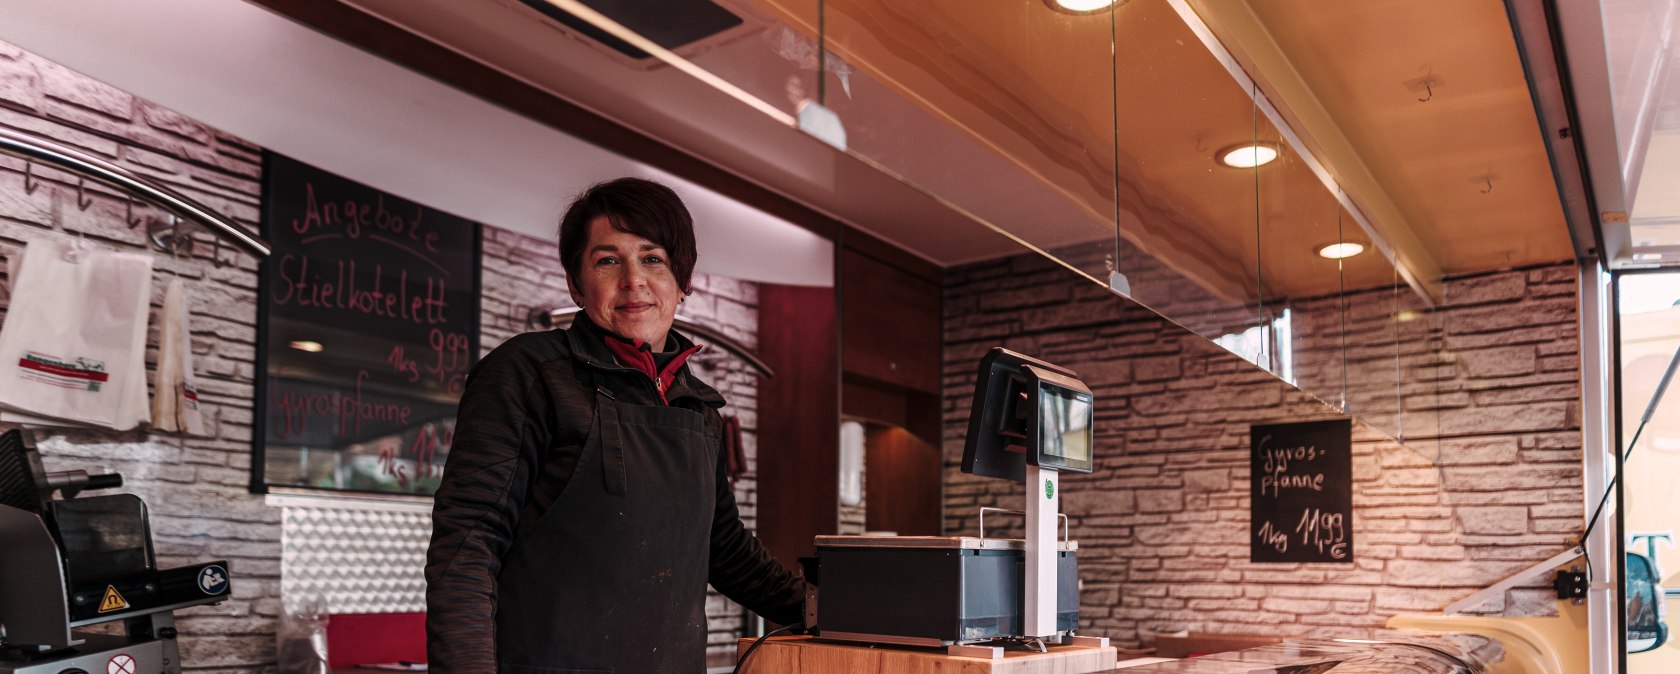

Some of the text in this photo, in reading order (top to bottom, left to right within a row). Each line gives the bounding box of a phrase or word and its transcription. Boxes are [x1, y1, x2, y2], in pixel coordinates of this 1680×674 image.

[292, 181, 440, 253] Angebote
[273, 252, 450, 324] Stielkotelett
[1258, 508, 1344, 554] 1kg 11,99
